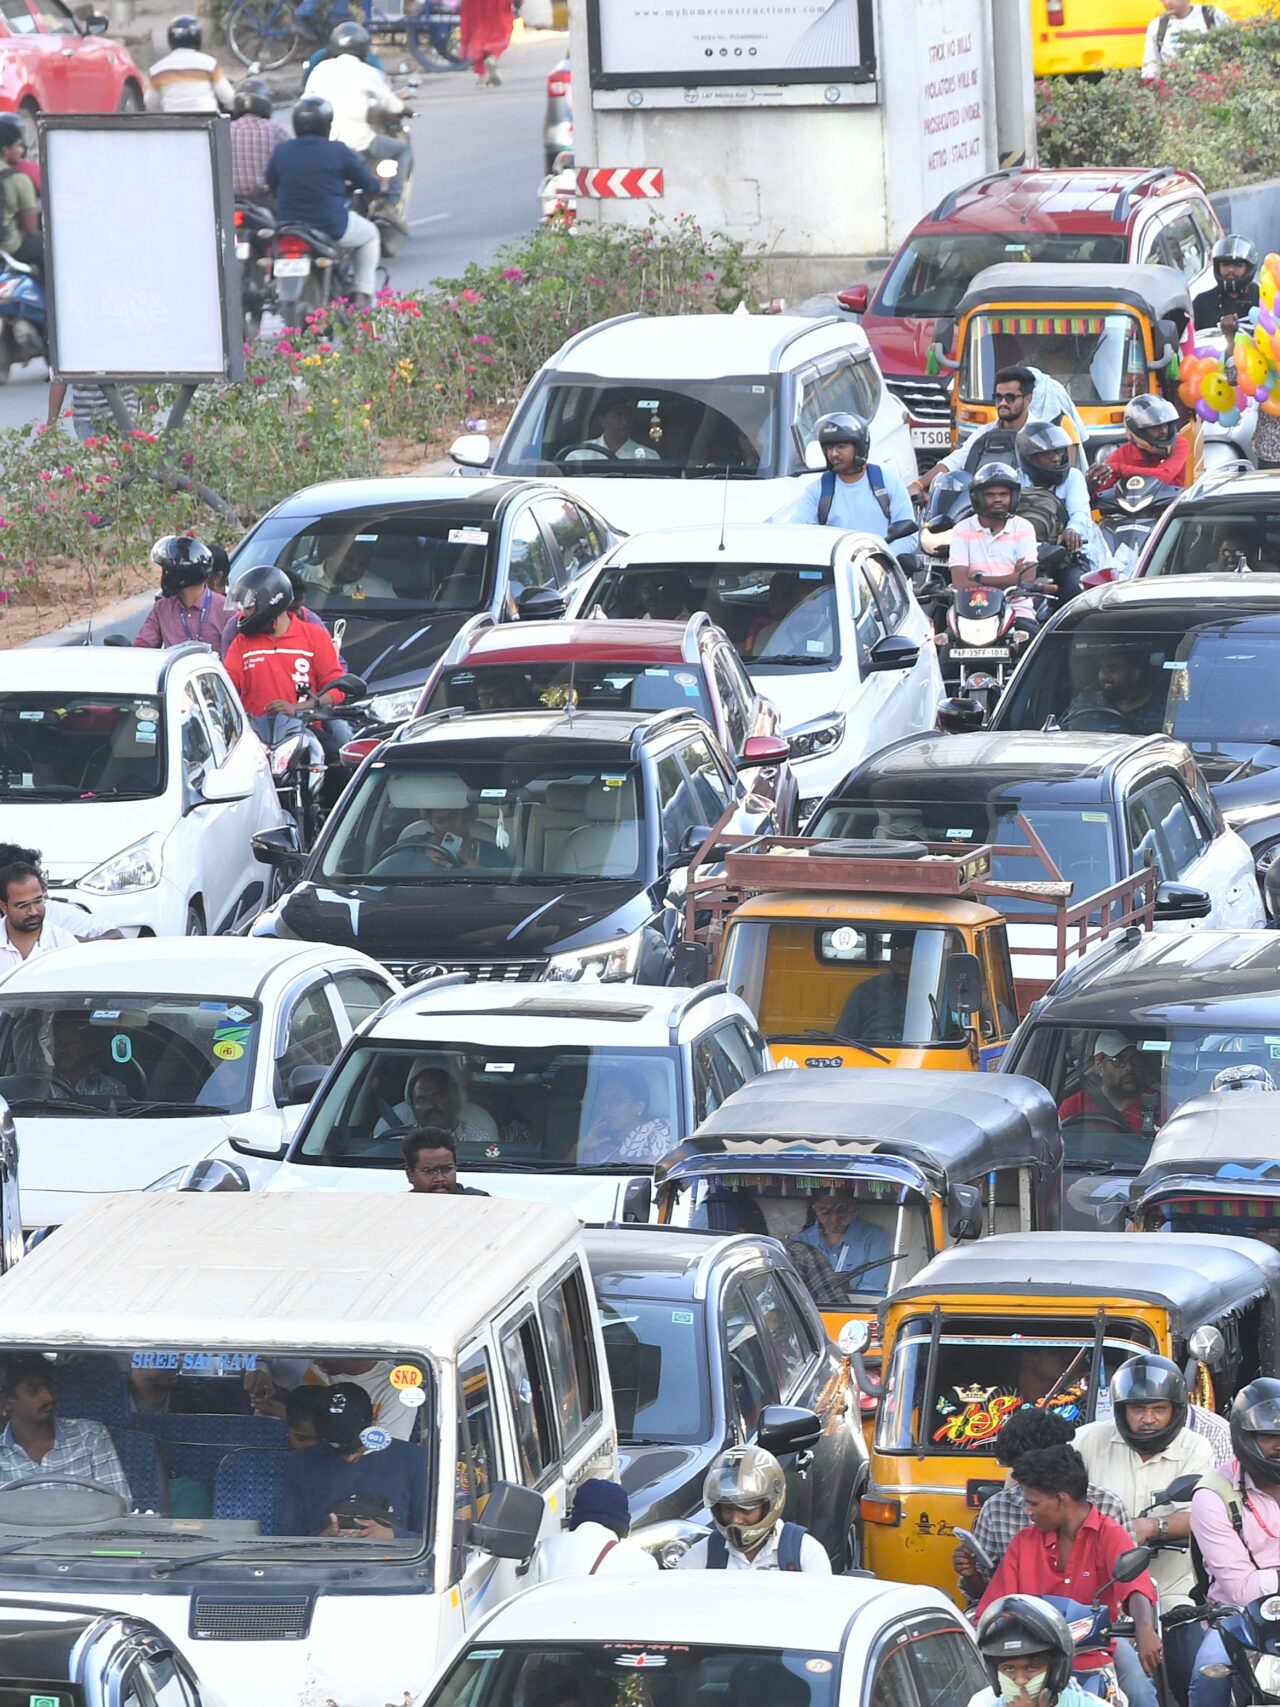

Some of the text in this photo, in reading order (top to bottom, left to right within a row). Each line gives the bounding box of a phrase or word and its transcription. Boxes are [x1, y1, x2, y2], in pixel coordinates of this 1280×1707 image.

[634, 5, 826, 18] www.myhomeconstructions.com
[132, 1352, 179, 1369] SREE
[218, 1353, 257, 1371] RAM
[394, 1370, 417, 1385] SKR
